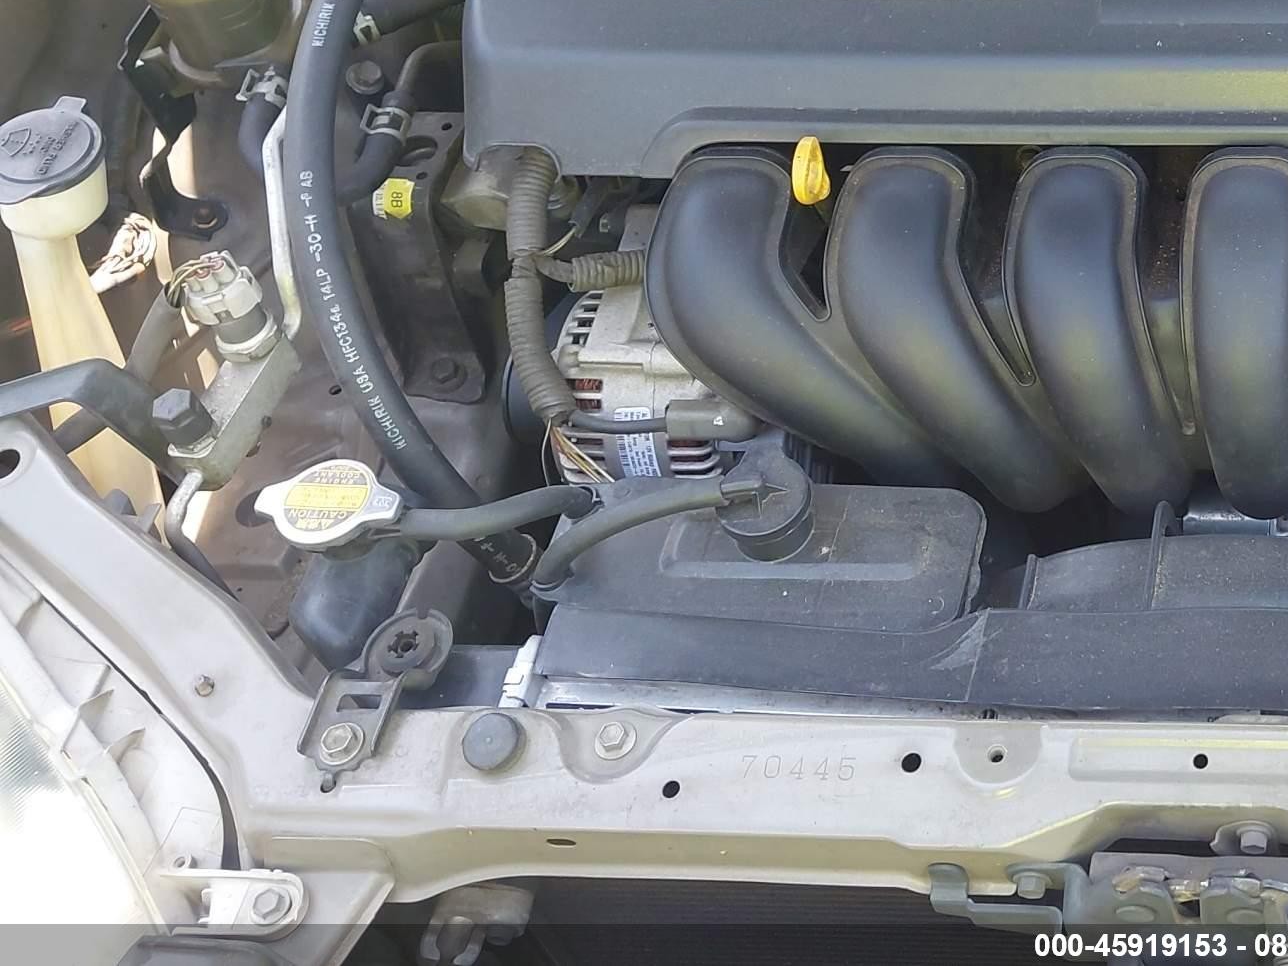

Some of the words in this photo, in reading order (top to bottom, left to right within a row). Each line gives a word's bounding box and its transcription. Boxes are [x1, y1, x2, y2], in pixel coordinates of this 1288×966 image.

[299, 170, 314, 188] AB
[315, 268, 337, 302] 14LP
[352, 364, 375, 394] USA
[288, 508, 348, 520] CAUTION
[741, 754, 857, 781] 70445
